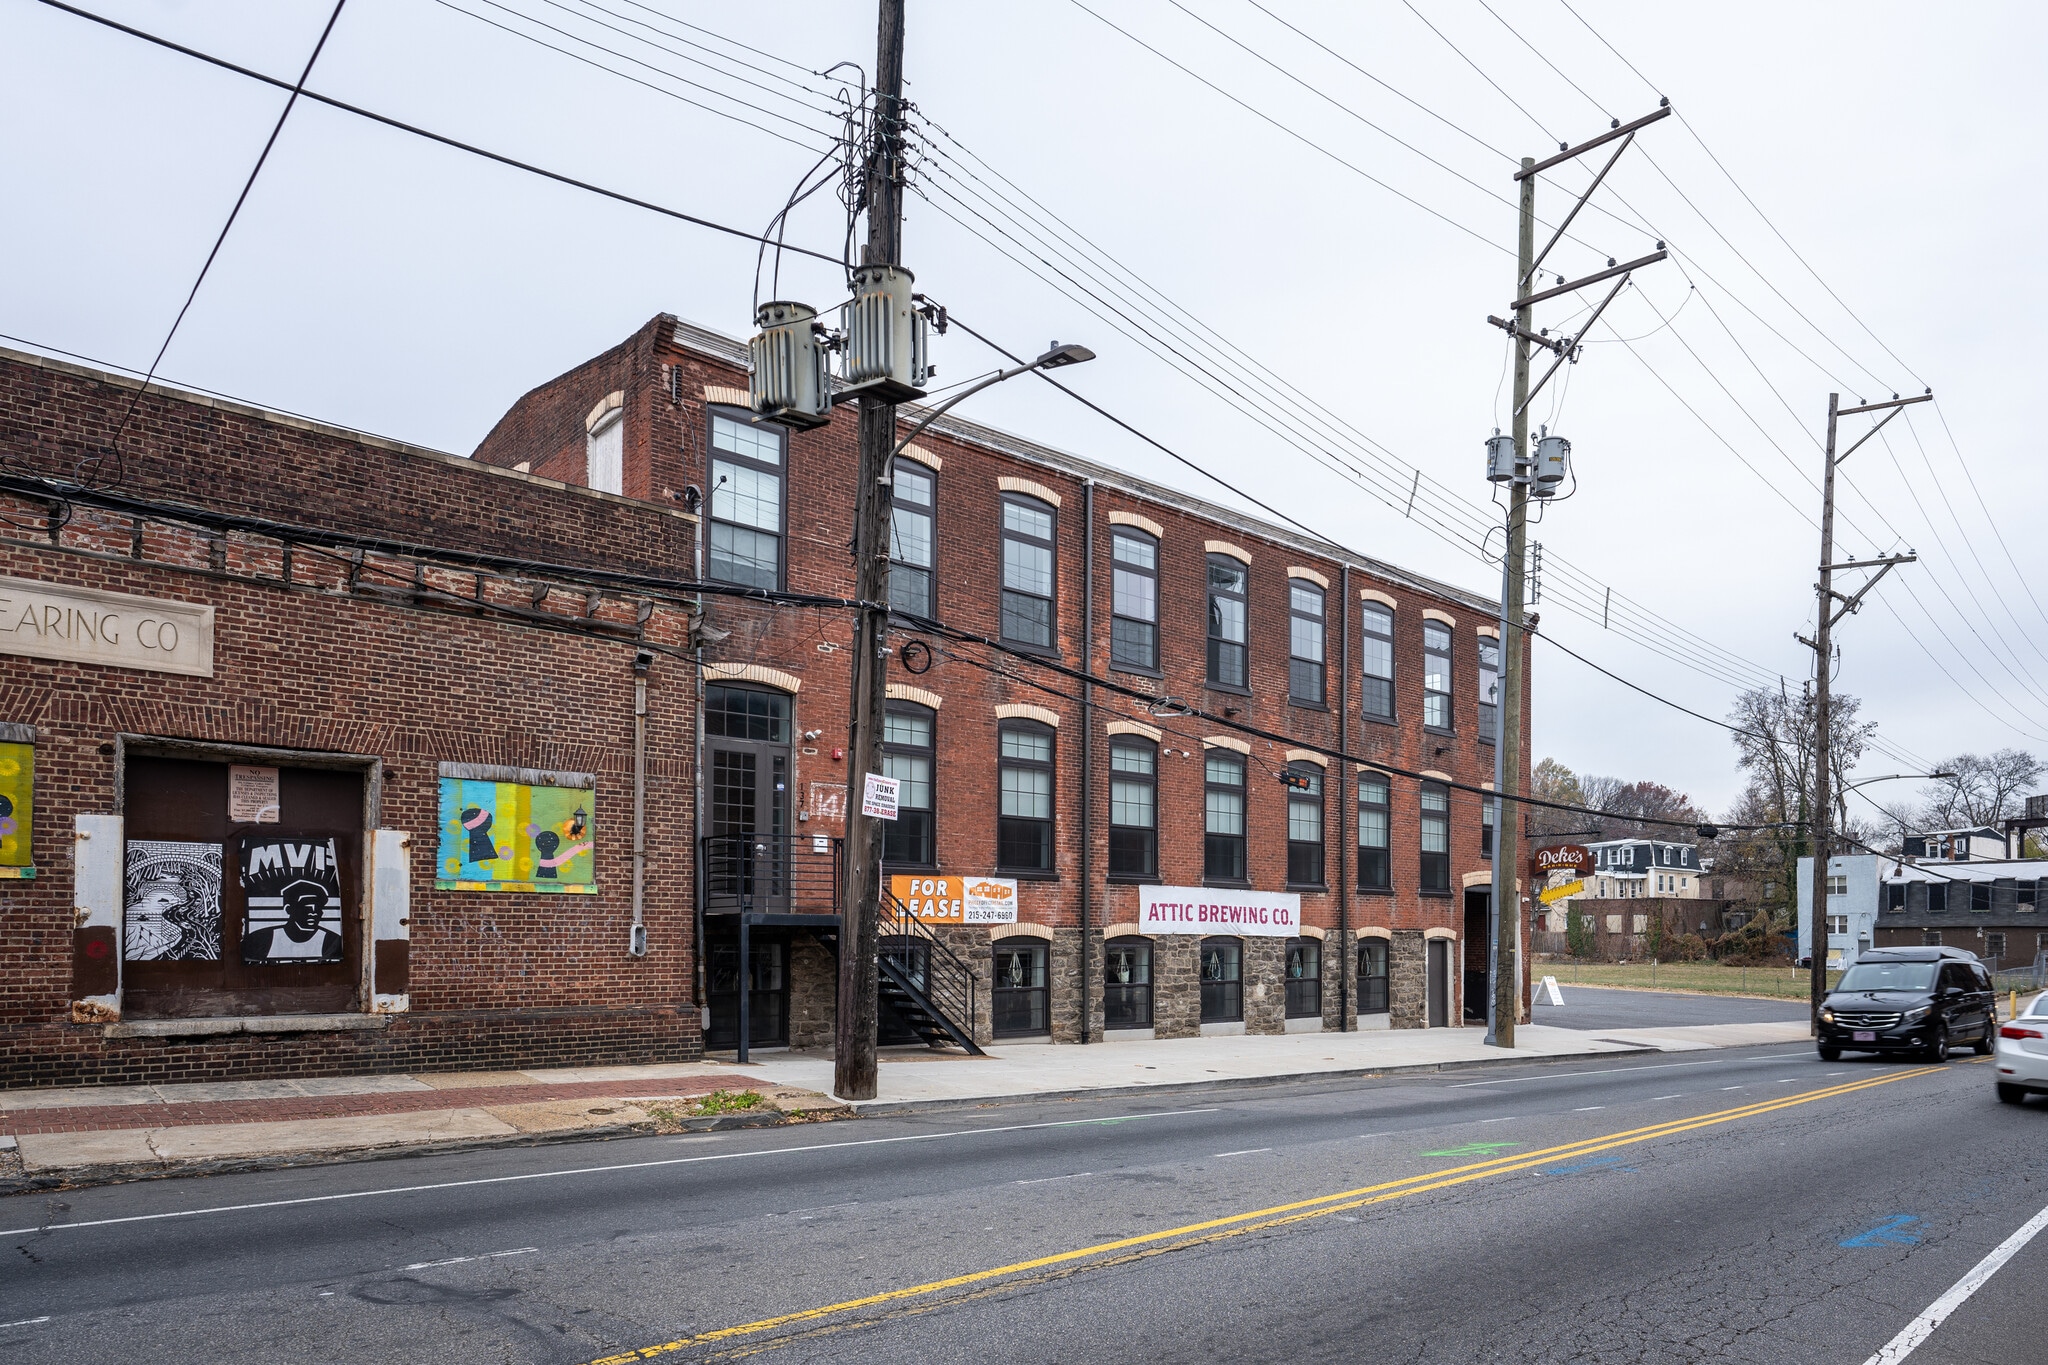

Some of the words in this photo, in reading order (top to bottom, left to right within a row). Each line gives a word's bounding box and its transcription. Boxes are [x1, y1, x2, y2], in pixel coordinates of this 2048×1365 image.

[136, 619, 179, 652] CO
[875, 793, 896, 803] REMOVAL
[876, 784, 895, 795] JUNK
[1538, 846, 1583, 867] Deke's
[909, 879, 948, 896] FOR
[896, 899, 961, 918] LEASE
[1148, 902, 1194, 922] ATTIC
[1198, 904, 1268, 925] BREWING
[1272, 908, 1294, 926] CO.
